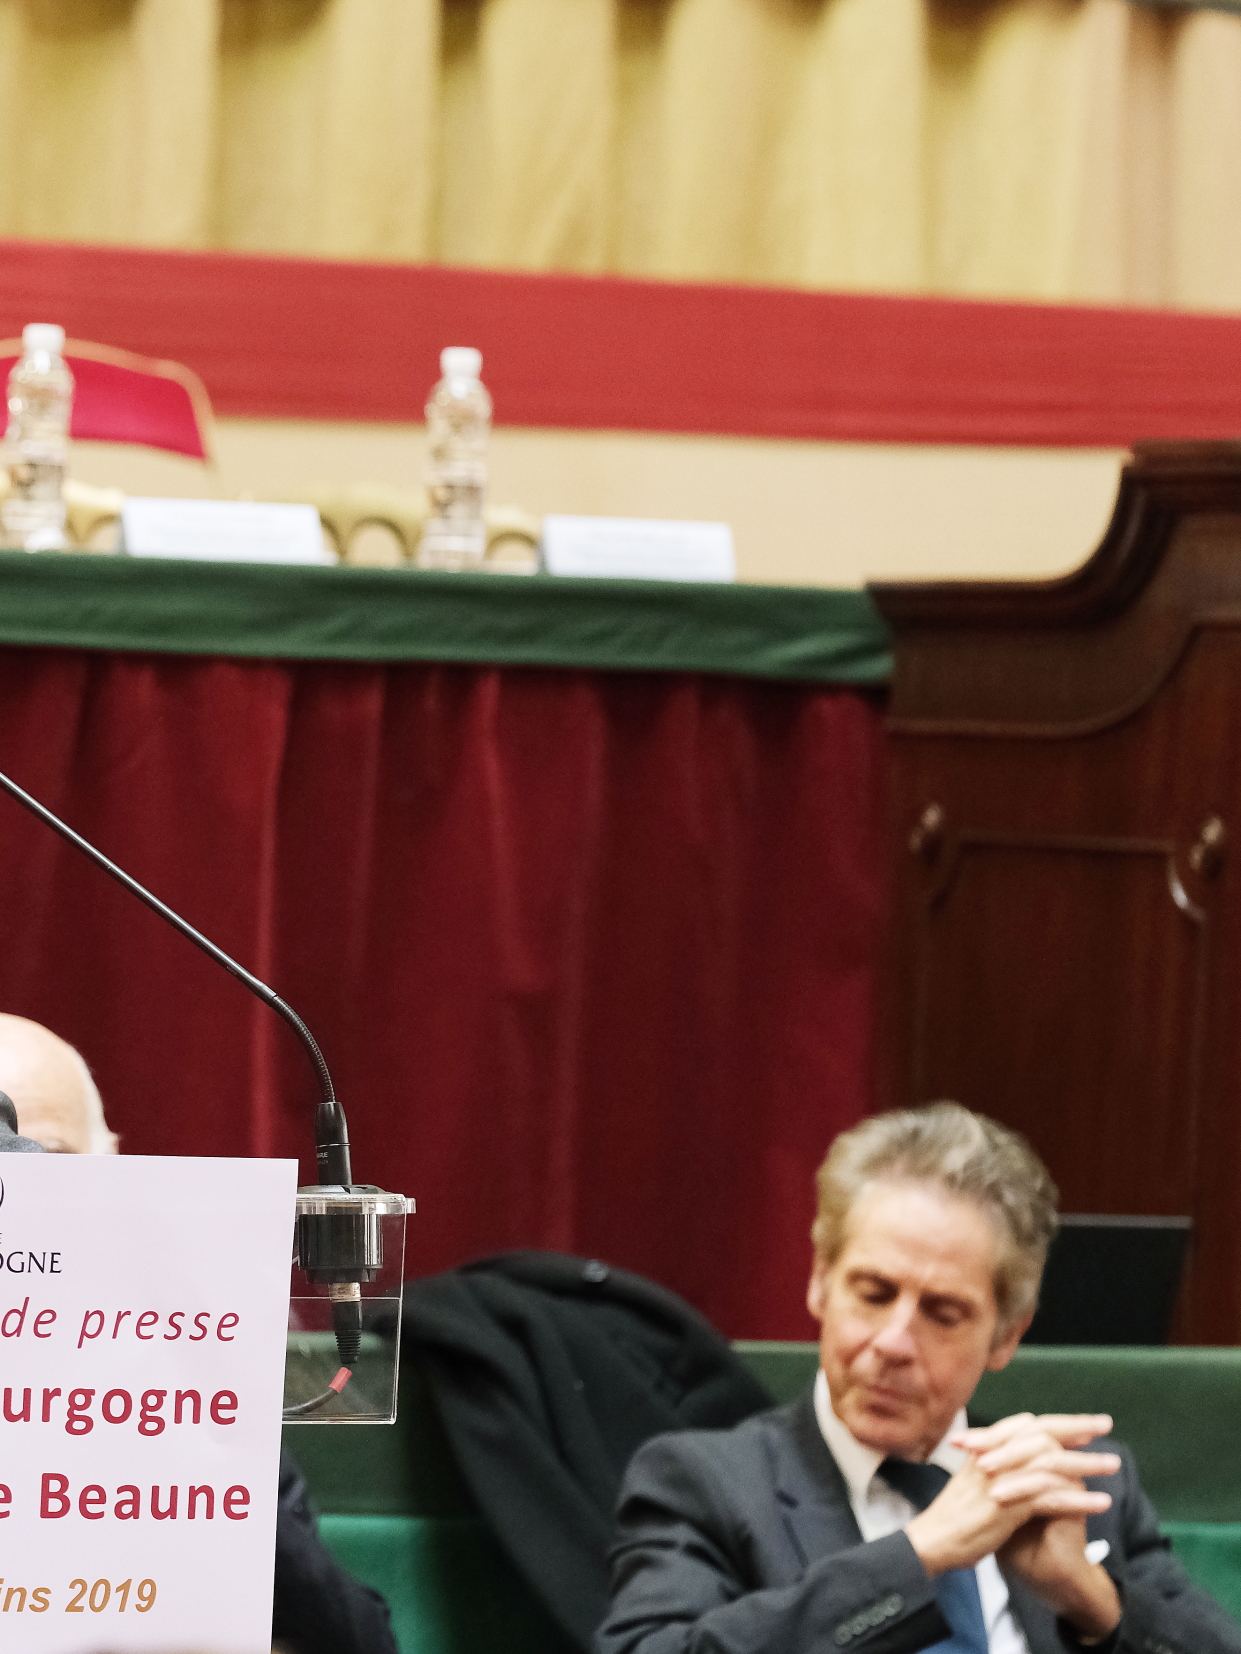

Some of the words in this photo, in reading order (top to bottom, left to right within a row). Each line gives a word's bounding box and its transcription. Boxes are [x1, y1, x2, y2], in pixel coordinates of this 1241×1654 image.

[0, 1296, 58, 1339] de
[76, 1309, 240, 1350] presse
[39, 1472, 251, 1521] Beaune
[64, 1578, 157, 1613] 2019
